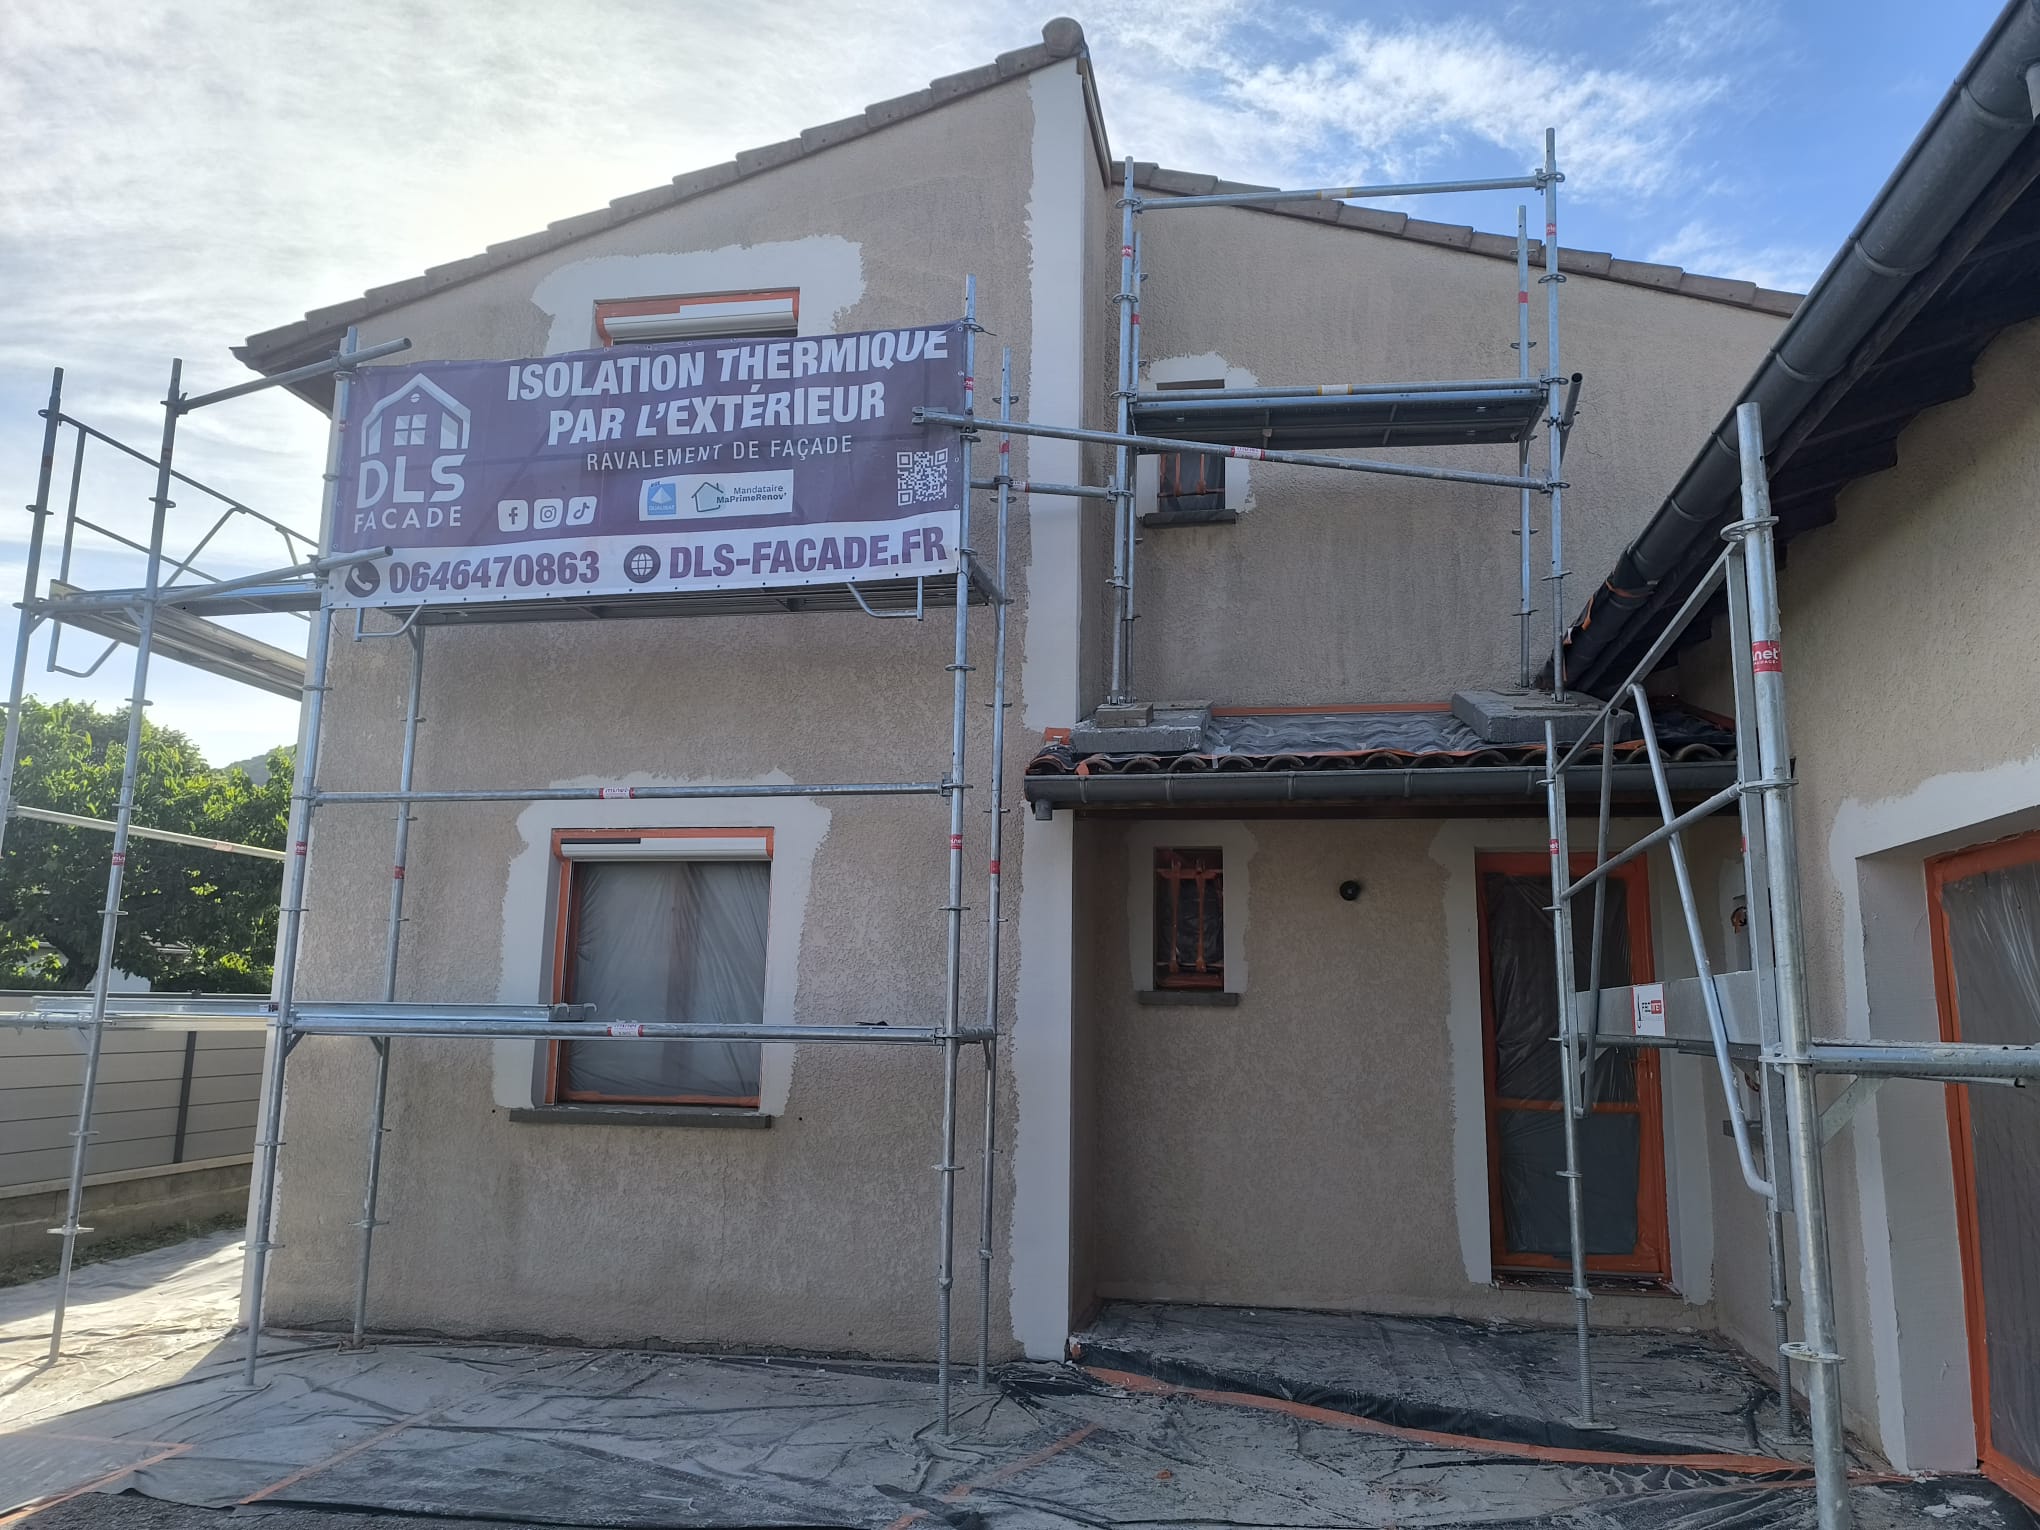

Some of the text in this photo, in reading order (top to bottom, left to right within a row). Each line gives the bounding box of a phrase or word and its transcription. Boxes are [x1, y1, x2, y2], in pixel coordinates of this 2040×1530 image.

[507, 330, 949, 401] ISOLATION THERMIQUE
[547, 407, 626, 446] PAR
[587, 435, 852, 471] RAVALEMENT DE FAÇADE
[356, 454, 466, 509] DLS
[733, 484, 784, 495] Mandataire
[353, 506, 462, 534] FACADE
[389, 551, 600, 593] 0646470863
[669, 526, 948, 579] DLS-FACADE.FR
